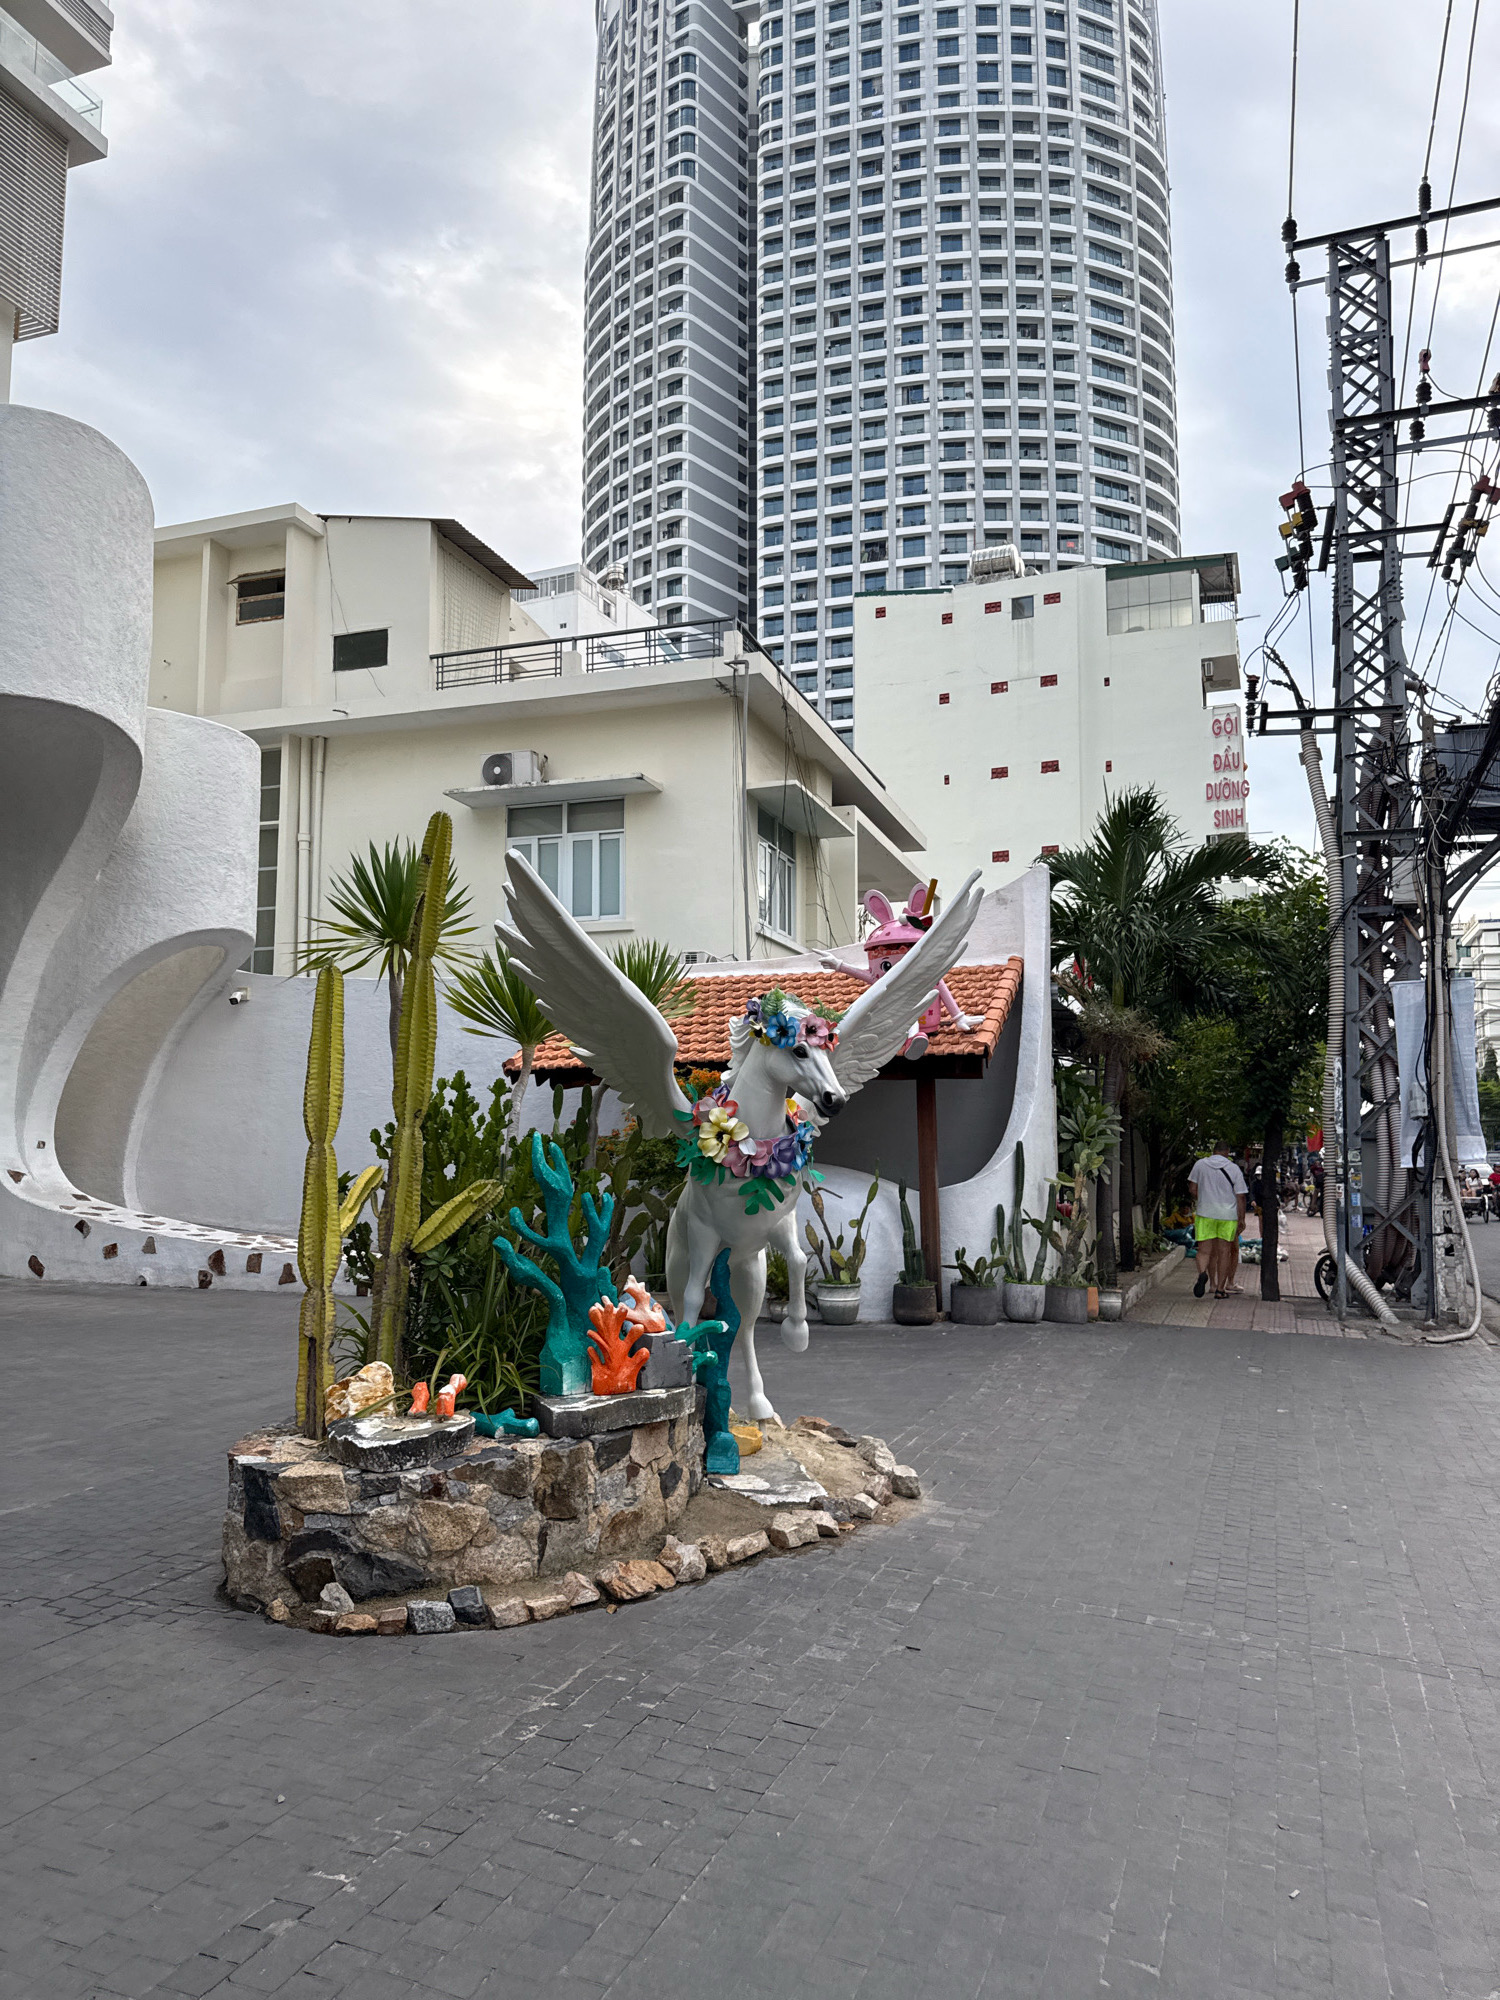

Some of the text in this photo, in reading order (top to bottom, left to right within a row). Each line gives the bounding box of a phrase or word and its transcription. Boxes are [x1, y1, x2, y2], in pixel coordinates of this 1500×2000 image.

[1212, 712, 1238, 740] GỘI
[1213, 745, 1240, 771] ĐẦU
[1206, 777, 1250, 801] DƯỠNG
[1213, 808, 1244, 828] SINH
